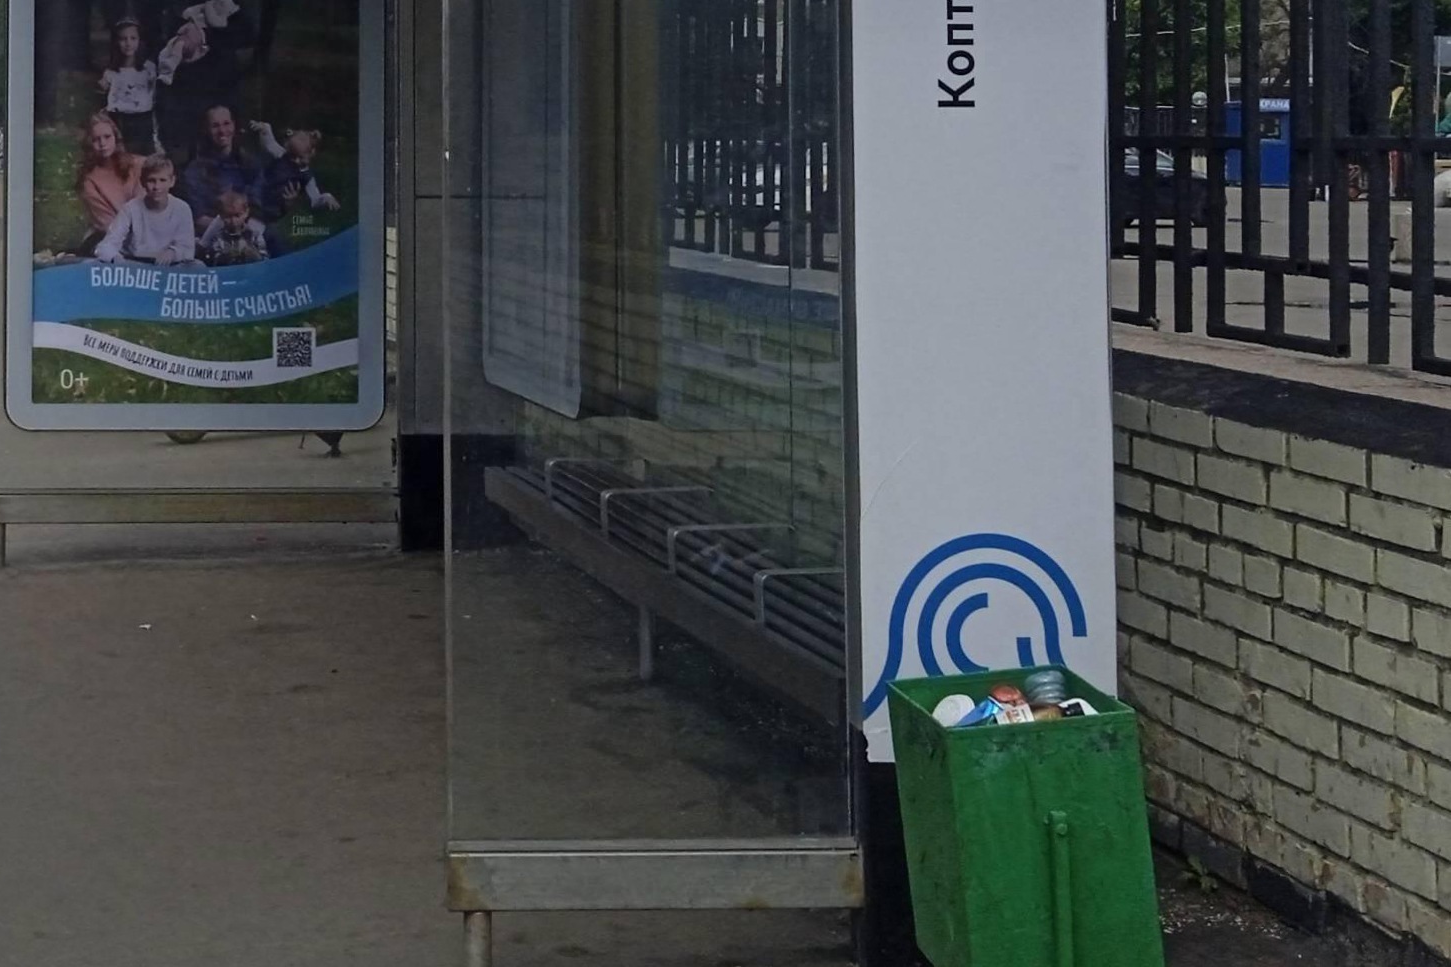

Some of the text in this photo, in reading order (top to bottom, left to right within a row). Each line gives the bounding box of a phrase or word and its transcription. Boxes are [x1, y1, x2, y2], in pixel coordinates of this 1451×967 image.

[1259, 99, 1289, 110] ХРАНА
[91, 267, 162, 291] БОЛЬШЕ
[164, 270, 219, 295] ДЕТЕЙ
[160, 284, 313, 319] БОЛЬШЕ СЧАСТЬЯ!
[98, 339, 120, 357] МЕРЫ
[120, 347, 168, 372] ПОДДЕРЖКИ
[168, 362, 186, 377] ДЛЯ
[186, 366, 213, 380] СЕМЕЙ
[220, 369, 253, 382] ДЕТЬМИ
[60, 368, 89, 389] 0+
